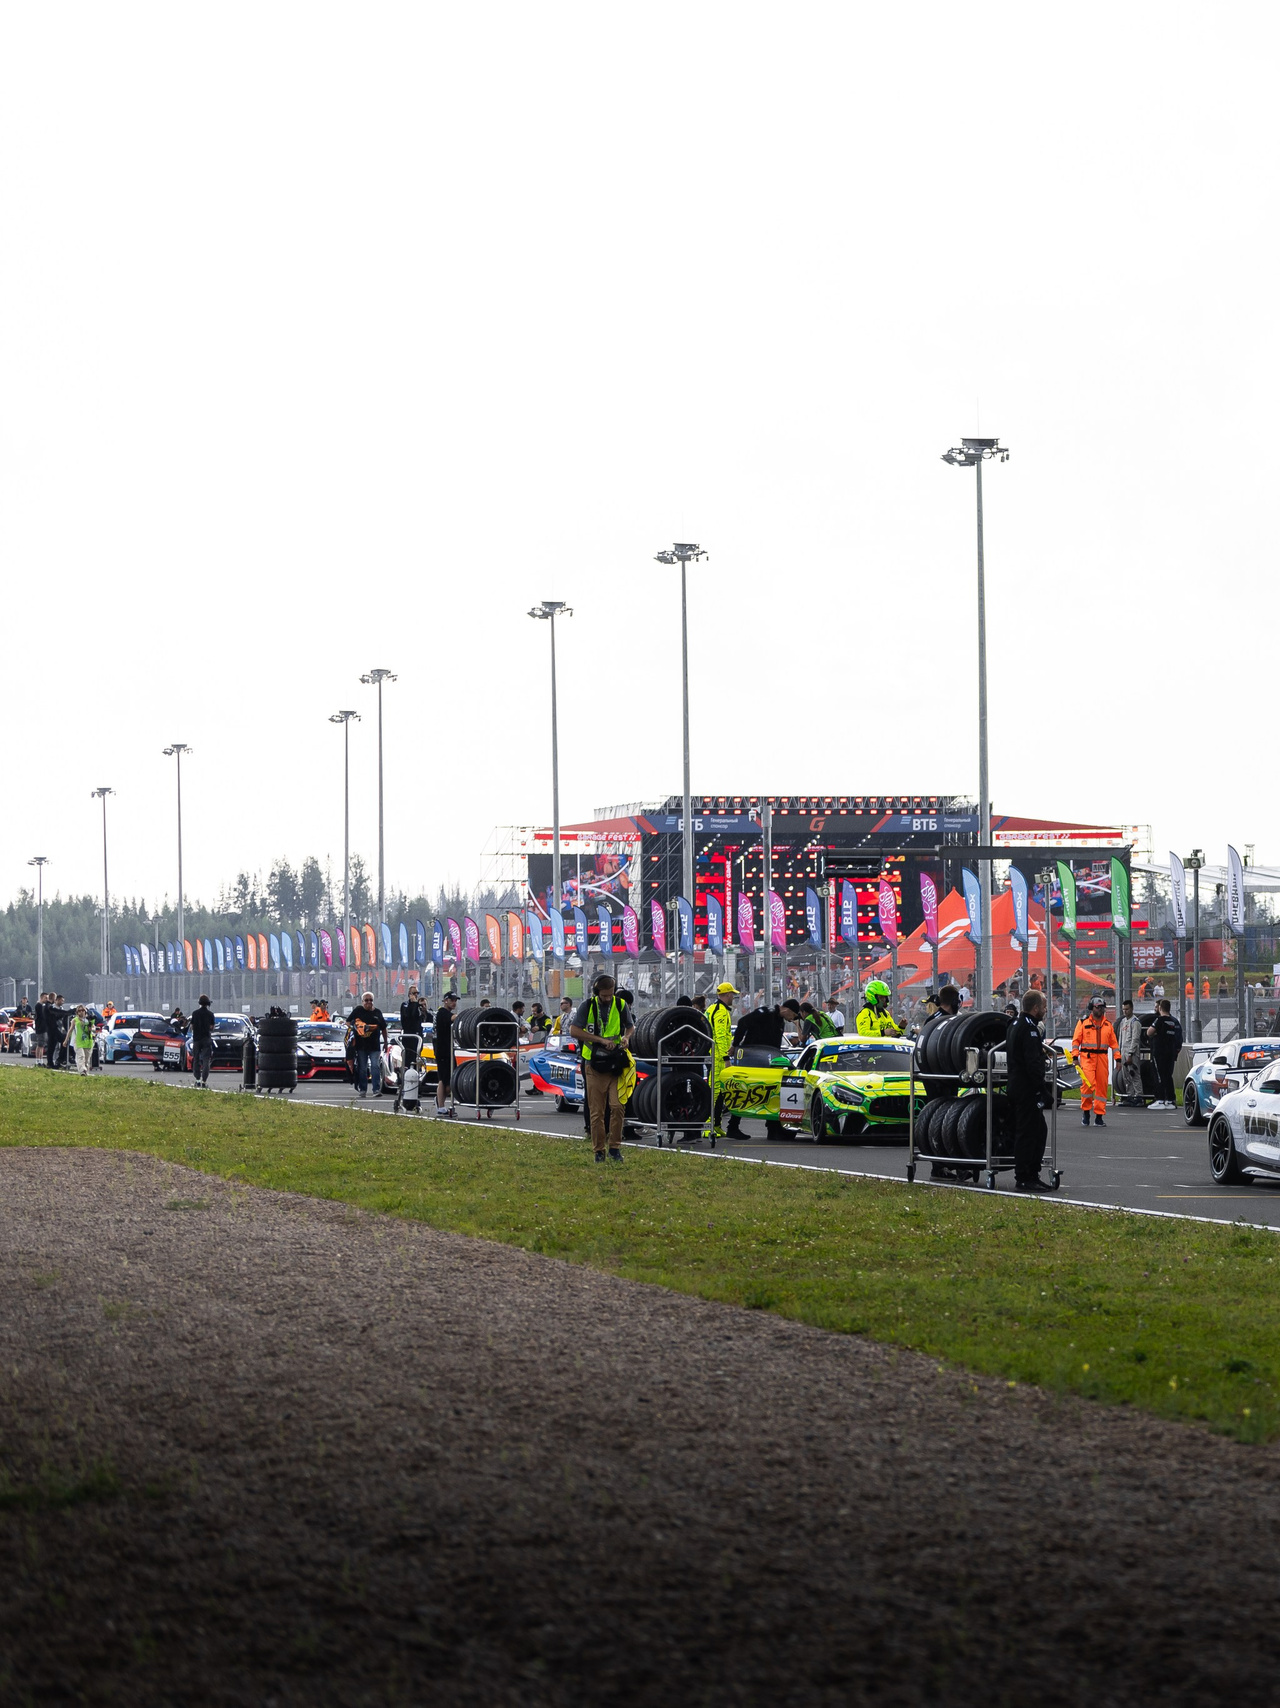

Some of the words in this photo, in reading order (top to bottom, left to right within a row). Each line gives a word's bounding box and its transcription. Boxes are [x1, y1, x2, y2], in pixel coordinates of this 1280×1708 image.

[912, 818, 937, 831] ВТБ
[163, 1051, 180, 1060] 555
[820, 1054, 838, 1063] 4
[550, 1063, 572, 1082] TRT
[724, 1078, 740, 1090] the
[721, 1084, 778, 1110] BEAST
[786, 1093, 798, 1105] 4
